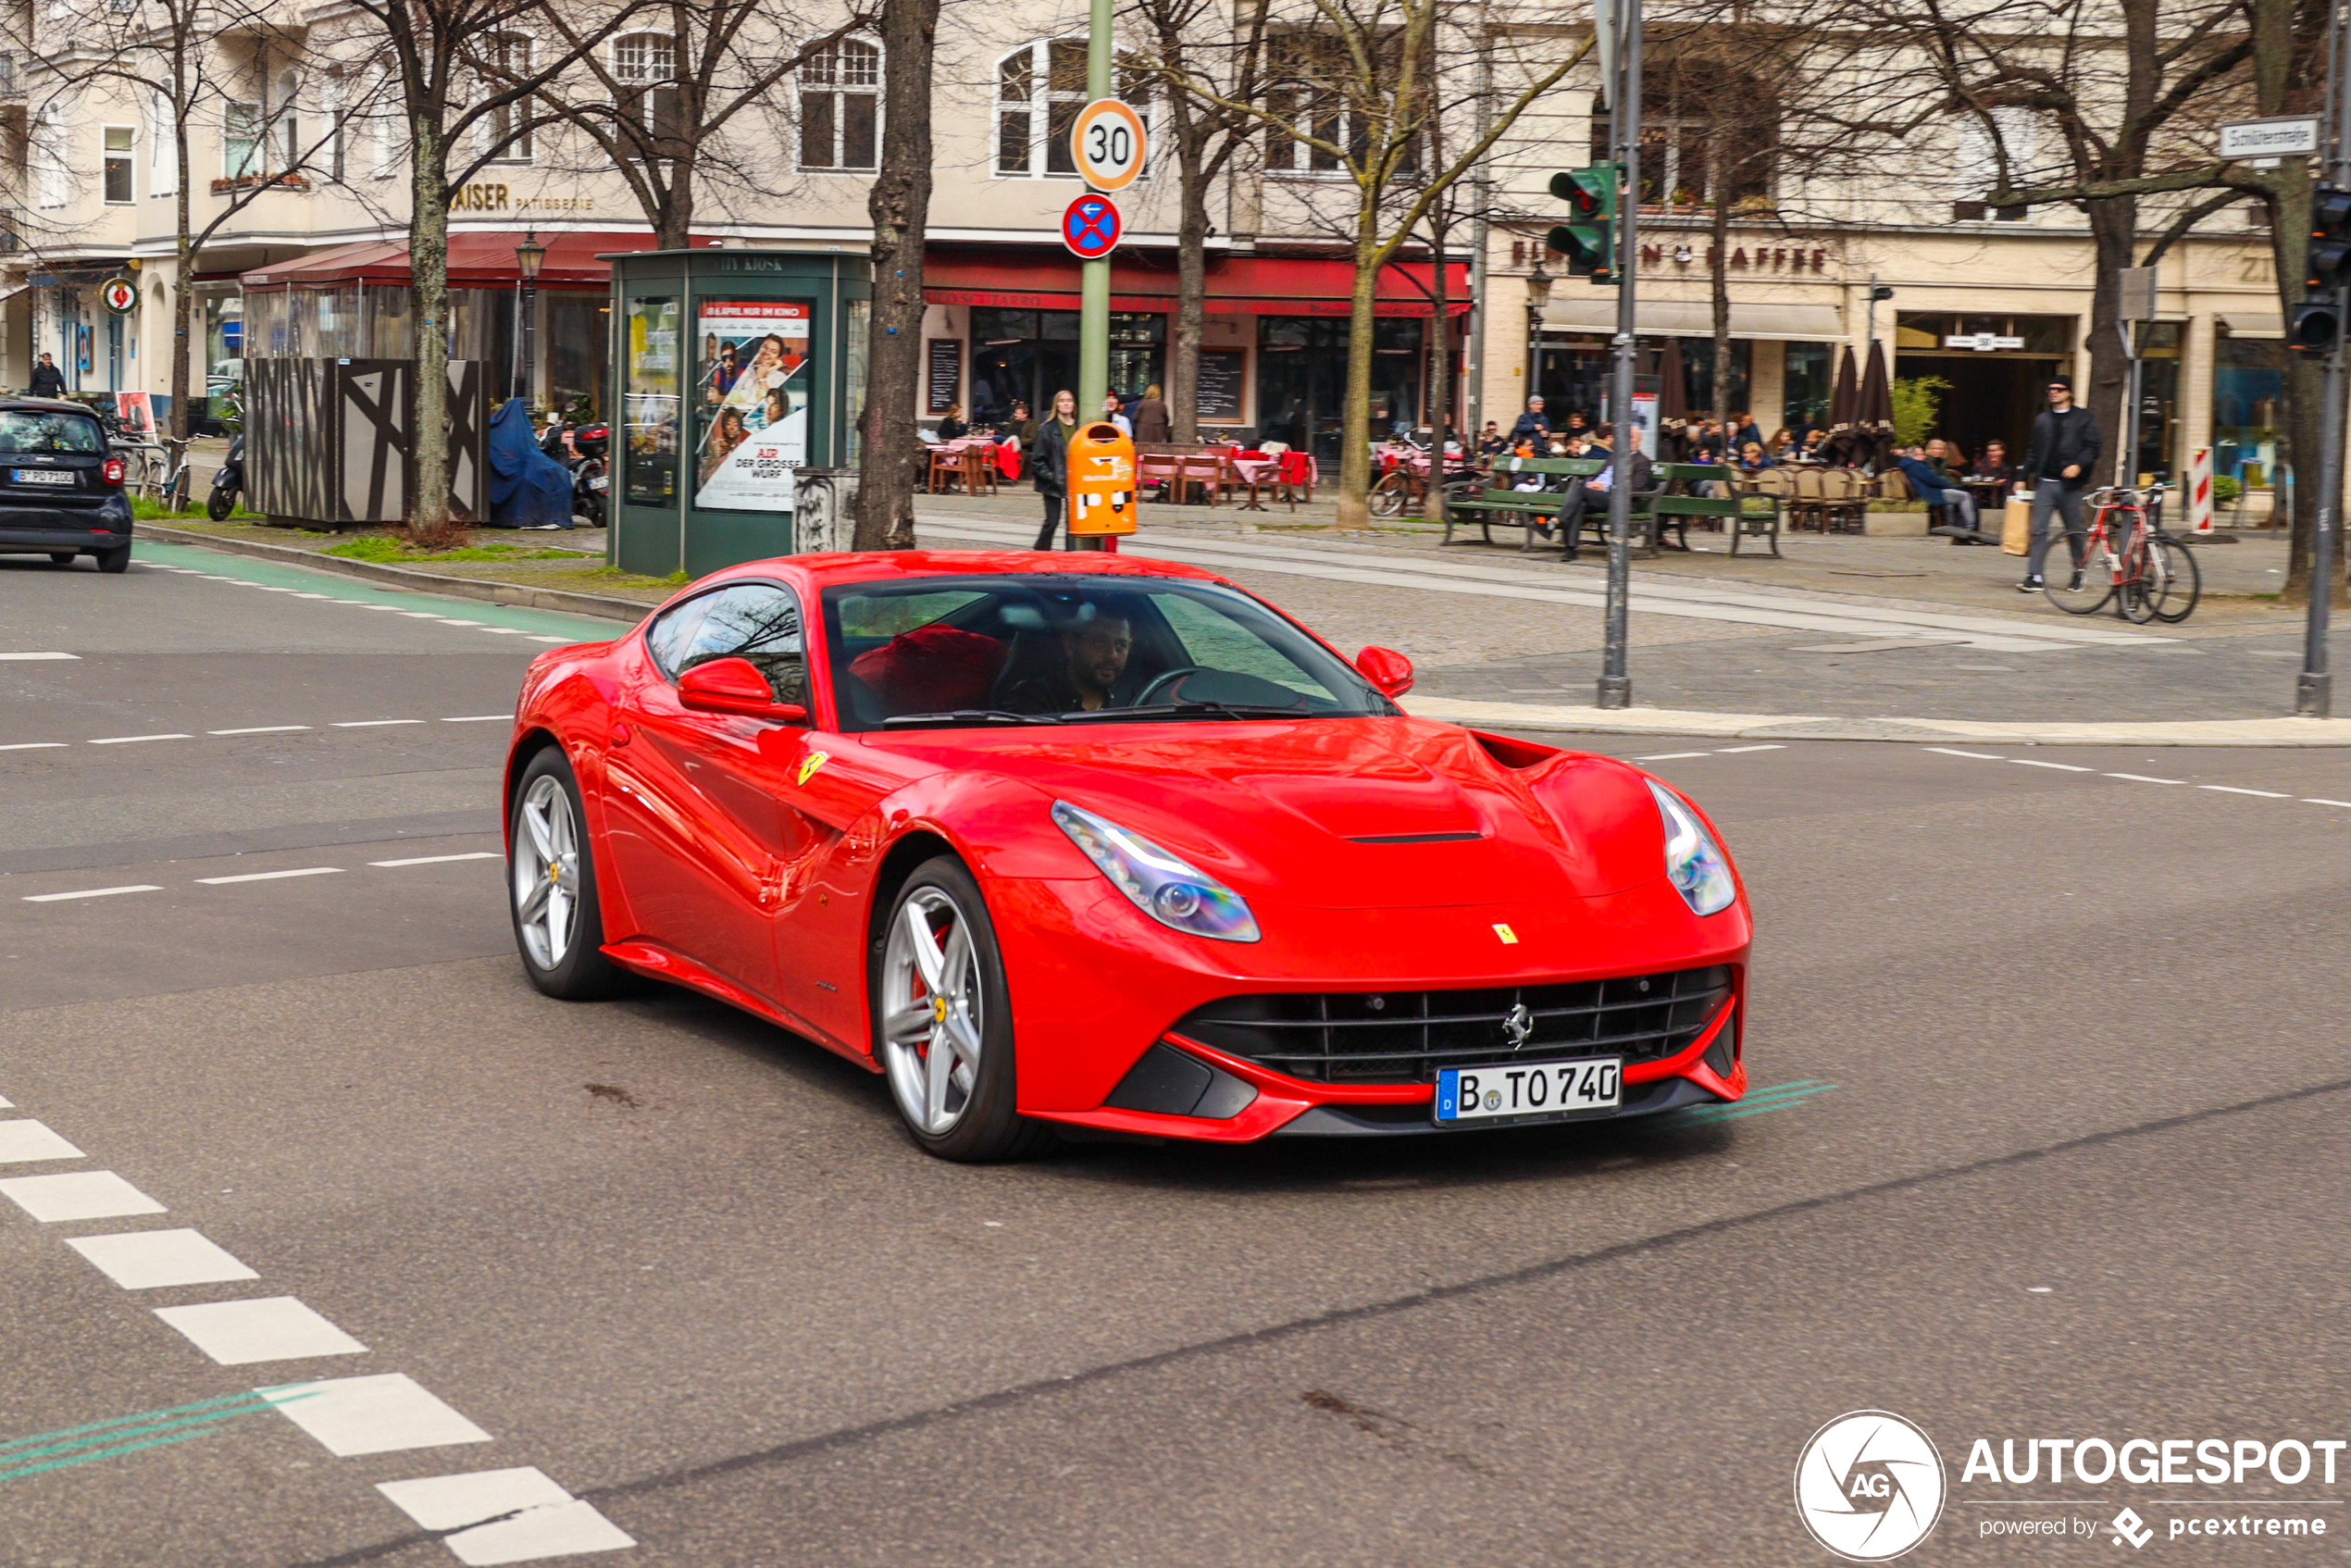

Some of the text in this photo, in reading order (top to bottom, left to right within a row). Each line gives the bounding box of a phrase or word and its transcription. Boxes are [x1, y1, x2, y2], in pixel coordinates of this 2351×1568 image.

[1089, 124, 1129, 165] 30
[450, 183, 594, 211] AISER PATISSERIE
[774, 308, 800, 317] KINO
[756, 448, 778, 458] AIR
[735, 458, 802, 469] DER GROSSE
[20, 470, 27, 480] B
[752, 469, 782, 479] WURF
[1443, 1064, 1617, 1113] D B TO 740
